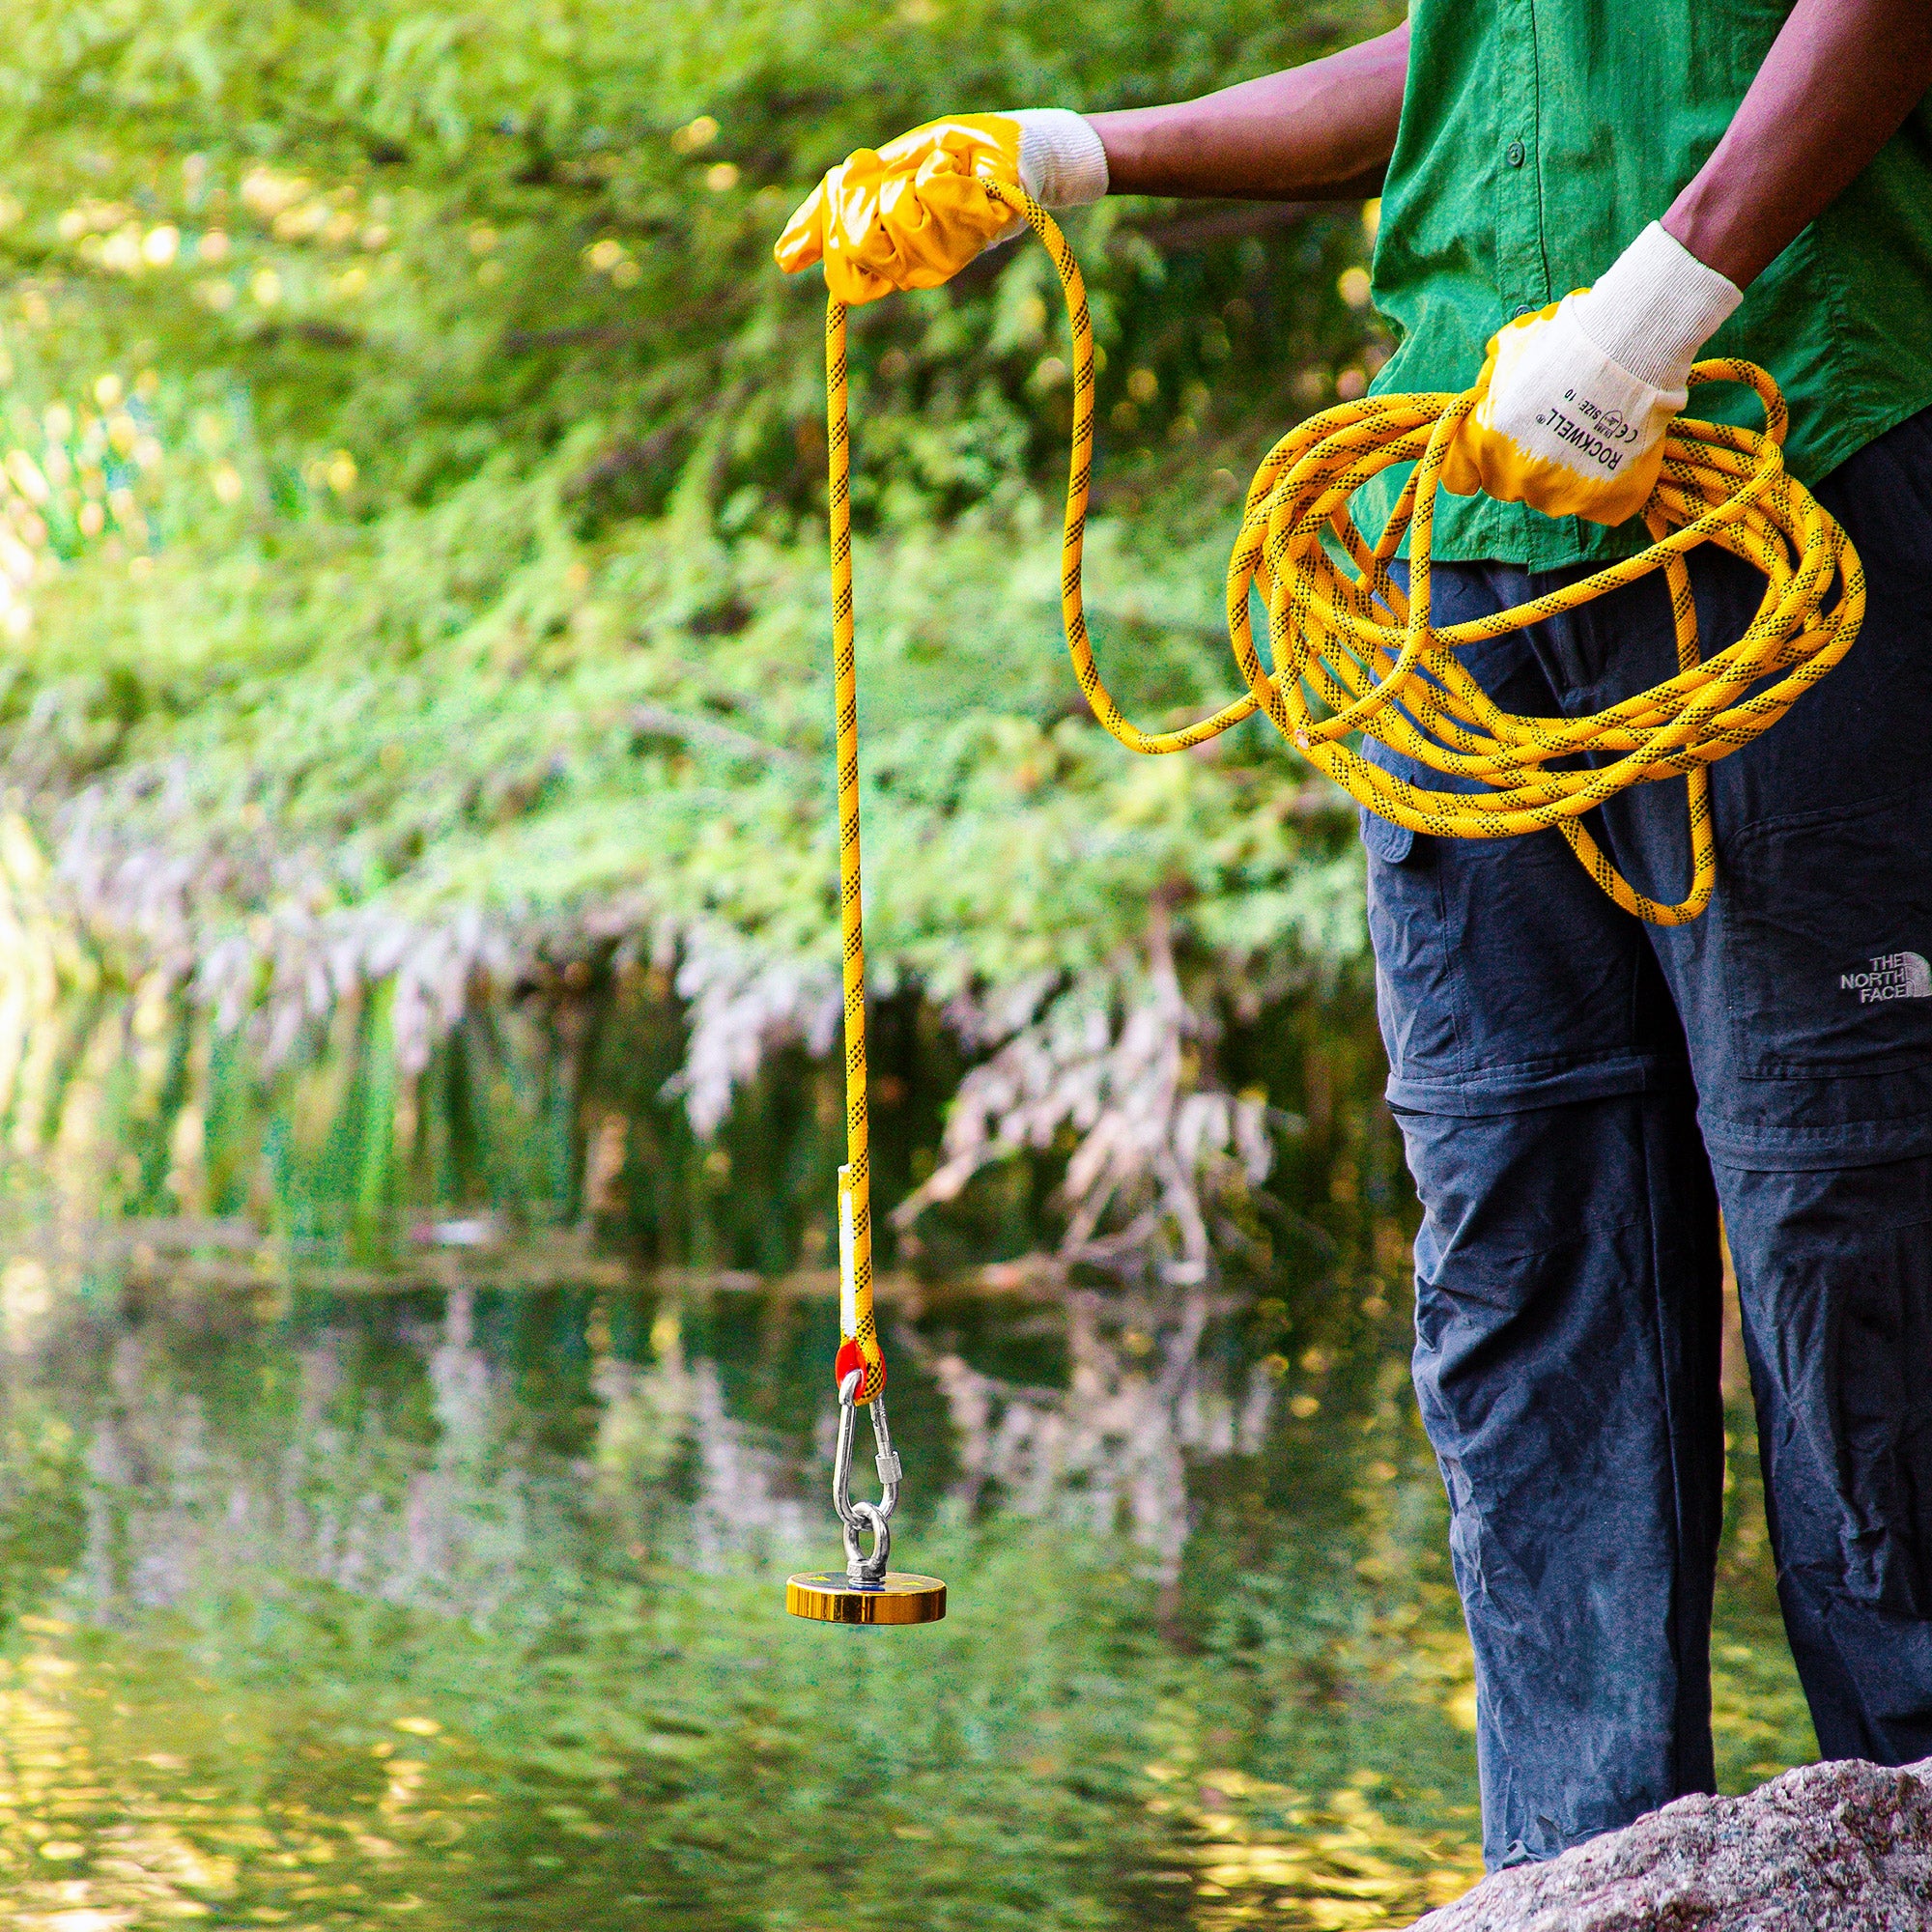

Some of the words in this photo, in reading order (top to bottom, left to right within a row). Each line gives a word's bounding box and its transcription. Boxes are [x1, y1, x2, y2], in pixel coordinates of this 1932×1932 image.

[1564, 388, 1577, 401] 10
[1869, 953, 1904, 971] THE
[1841, 968, 1905, 989] NORTH
[1861, 983, 1907, 1003] FACE
